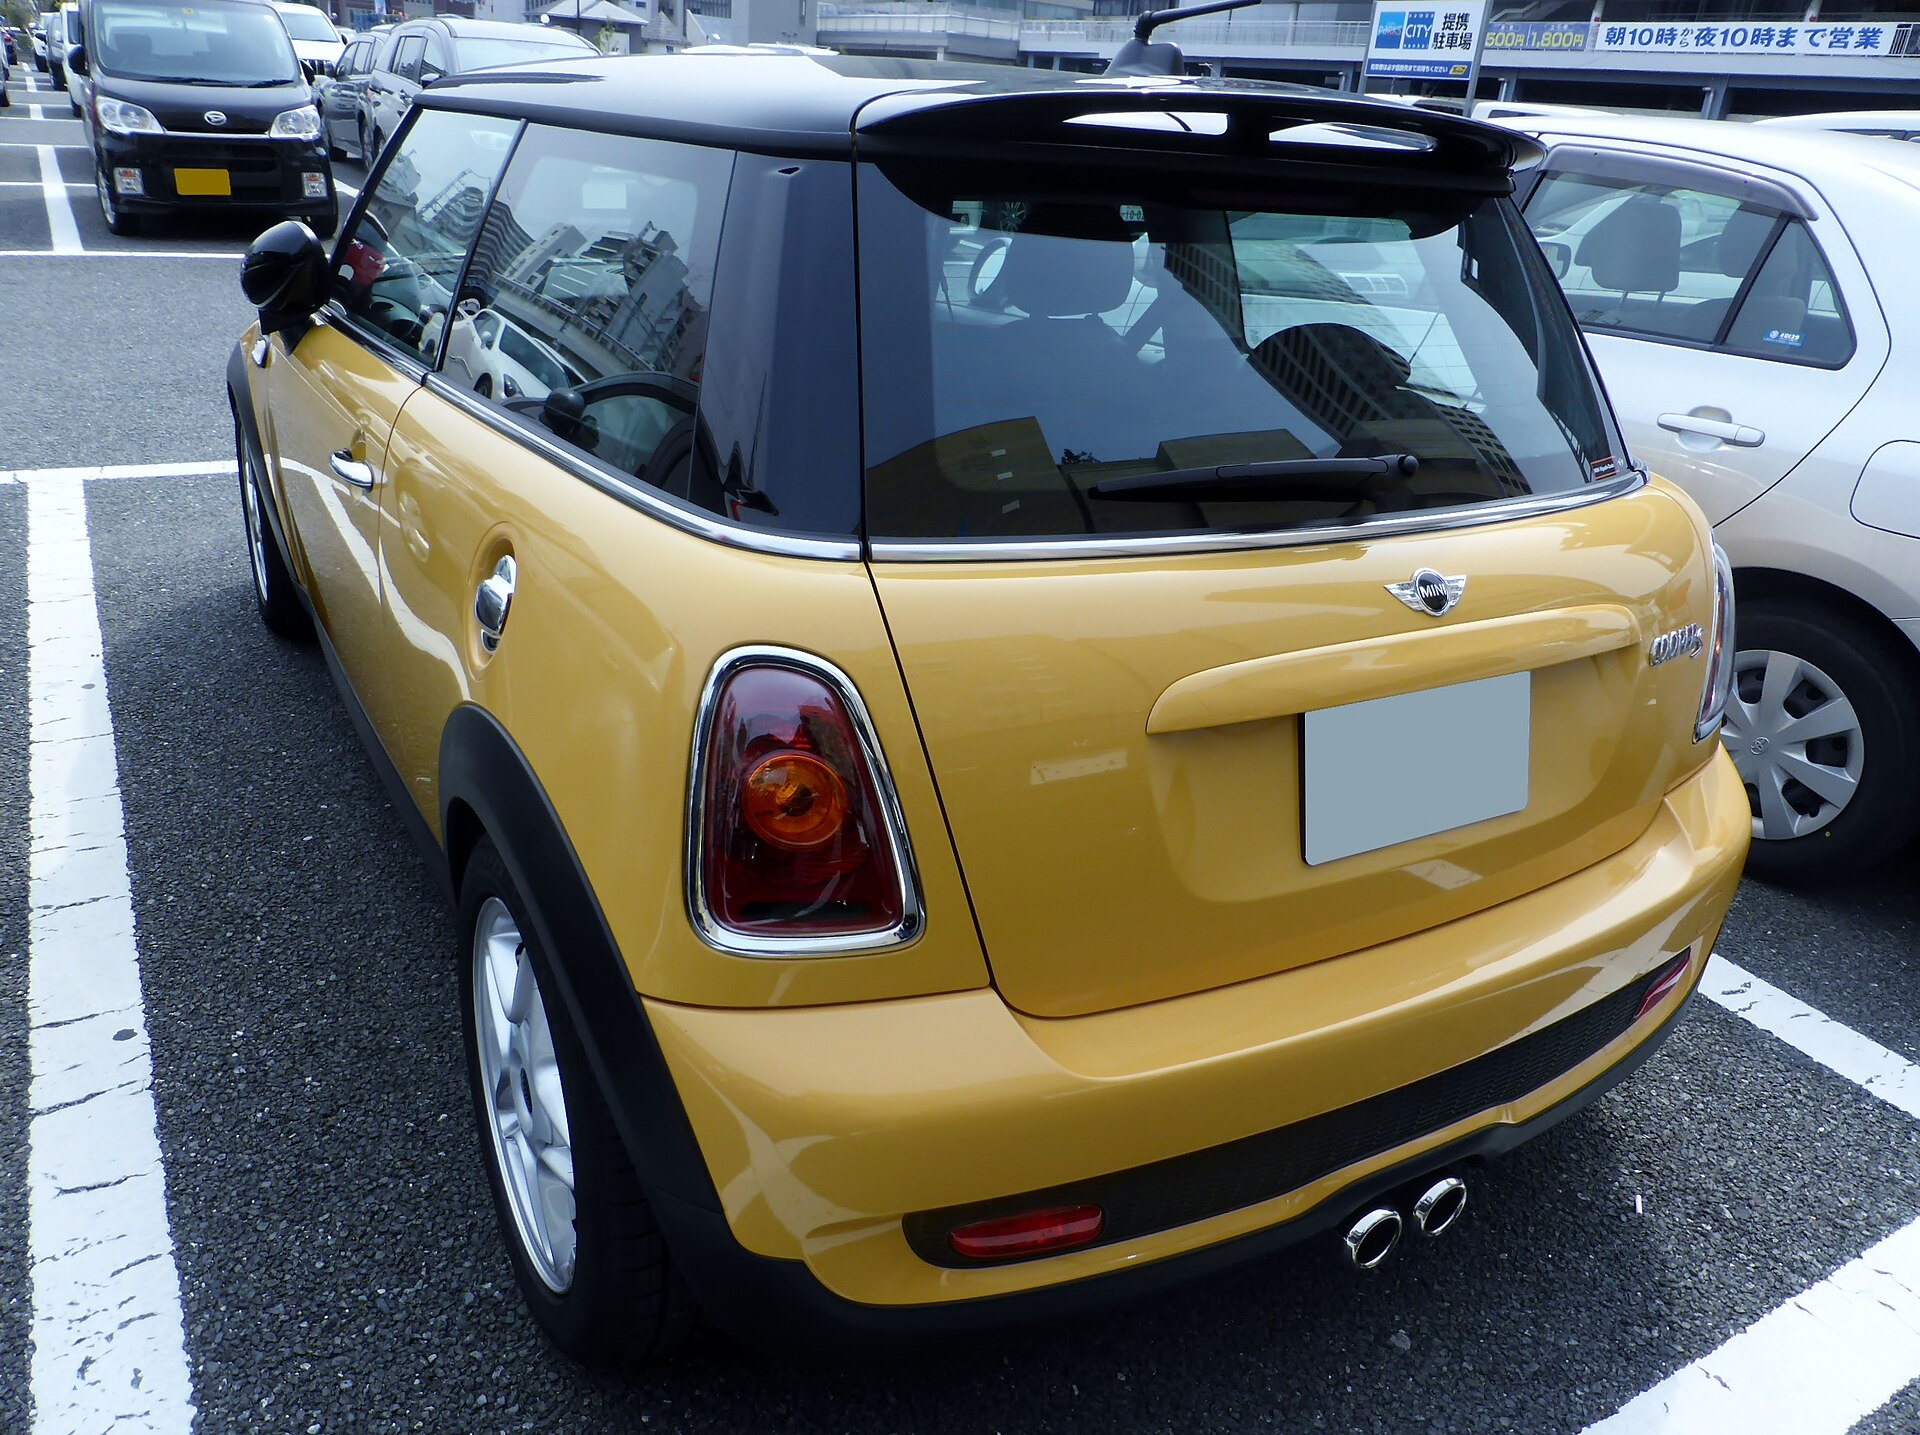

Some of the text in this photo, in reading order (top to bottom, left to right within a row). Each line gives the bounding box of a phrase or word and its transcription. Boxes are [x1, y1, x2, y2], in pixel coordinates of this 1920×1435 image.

[1442, 13, 1470, 31] 提携
[1405, 24, 1432, 38] CITY
[1485, 31, 1584, 48] 500円 1,800円
[1604, 26, 1884, 50] 朝10時から夜10時まで営業
[1432, 32, 1472, 50] 駐車場
[1418, 582, 1447, 598] MINI
